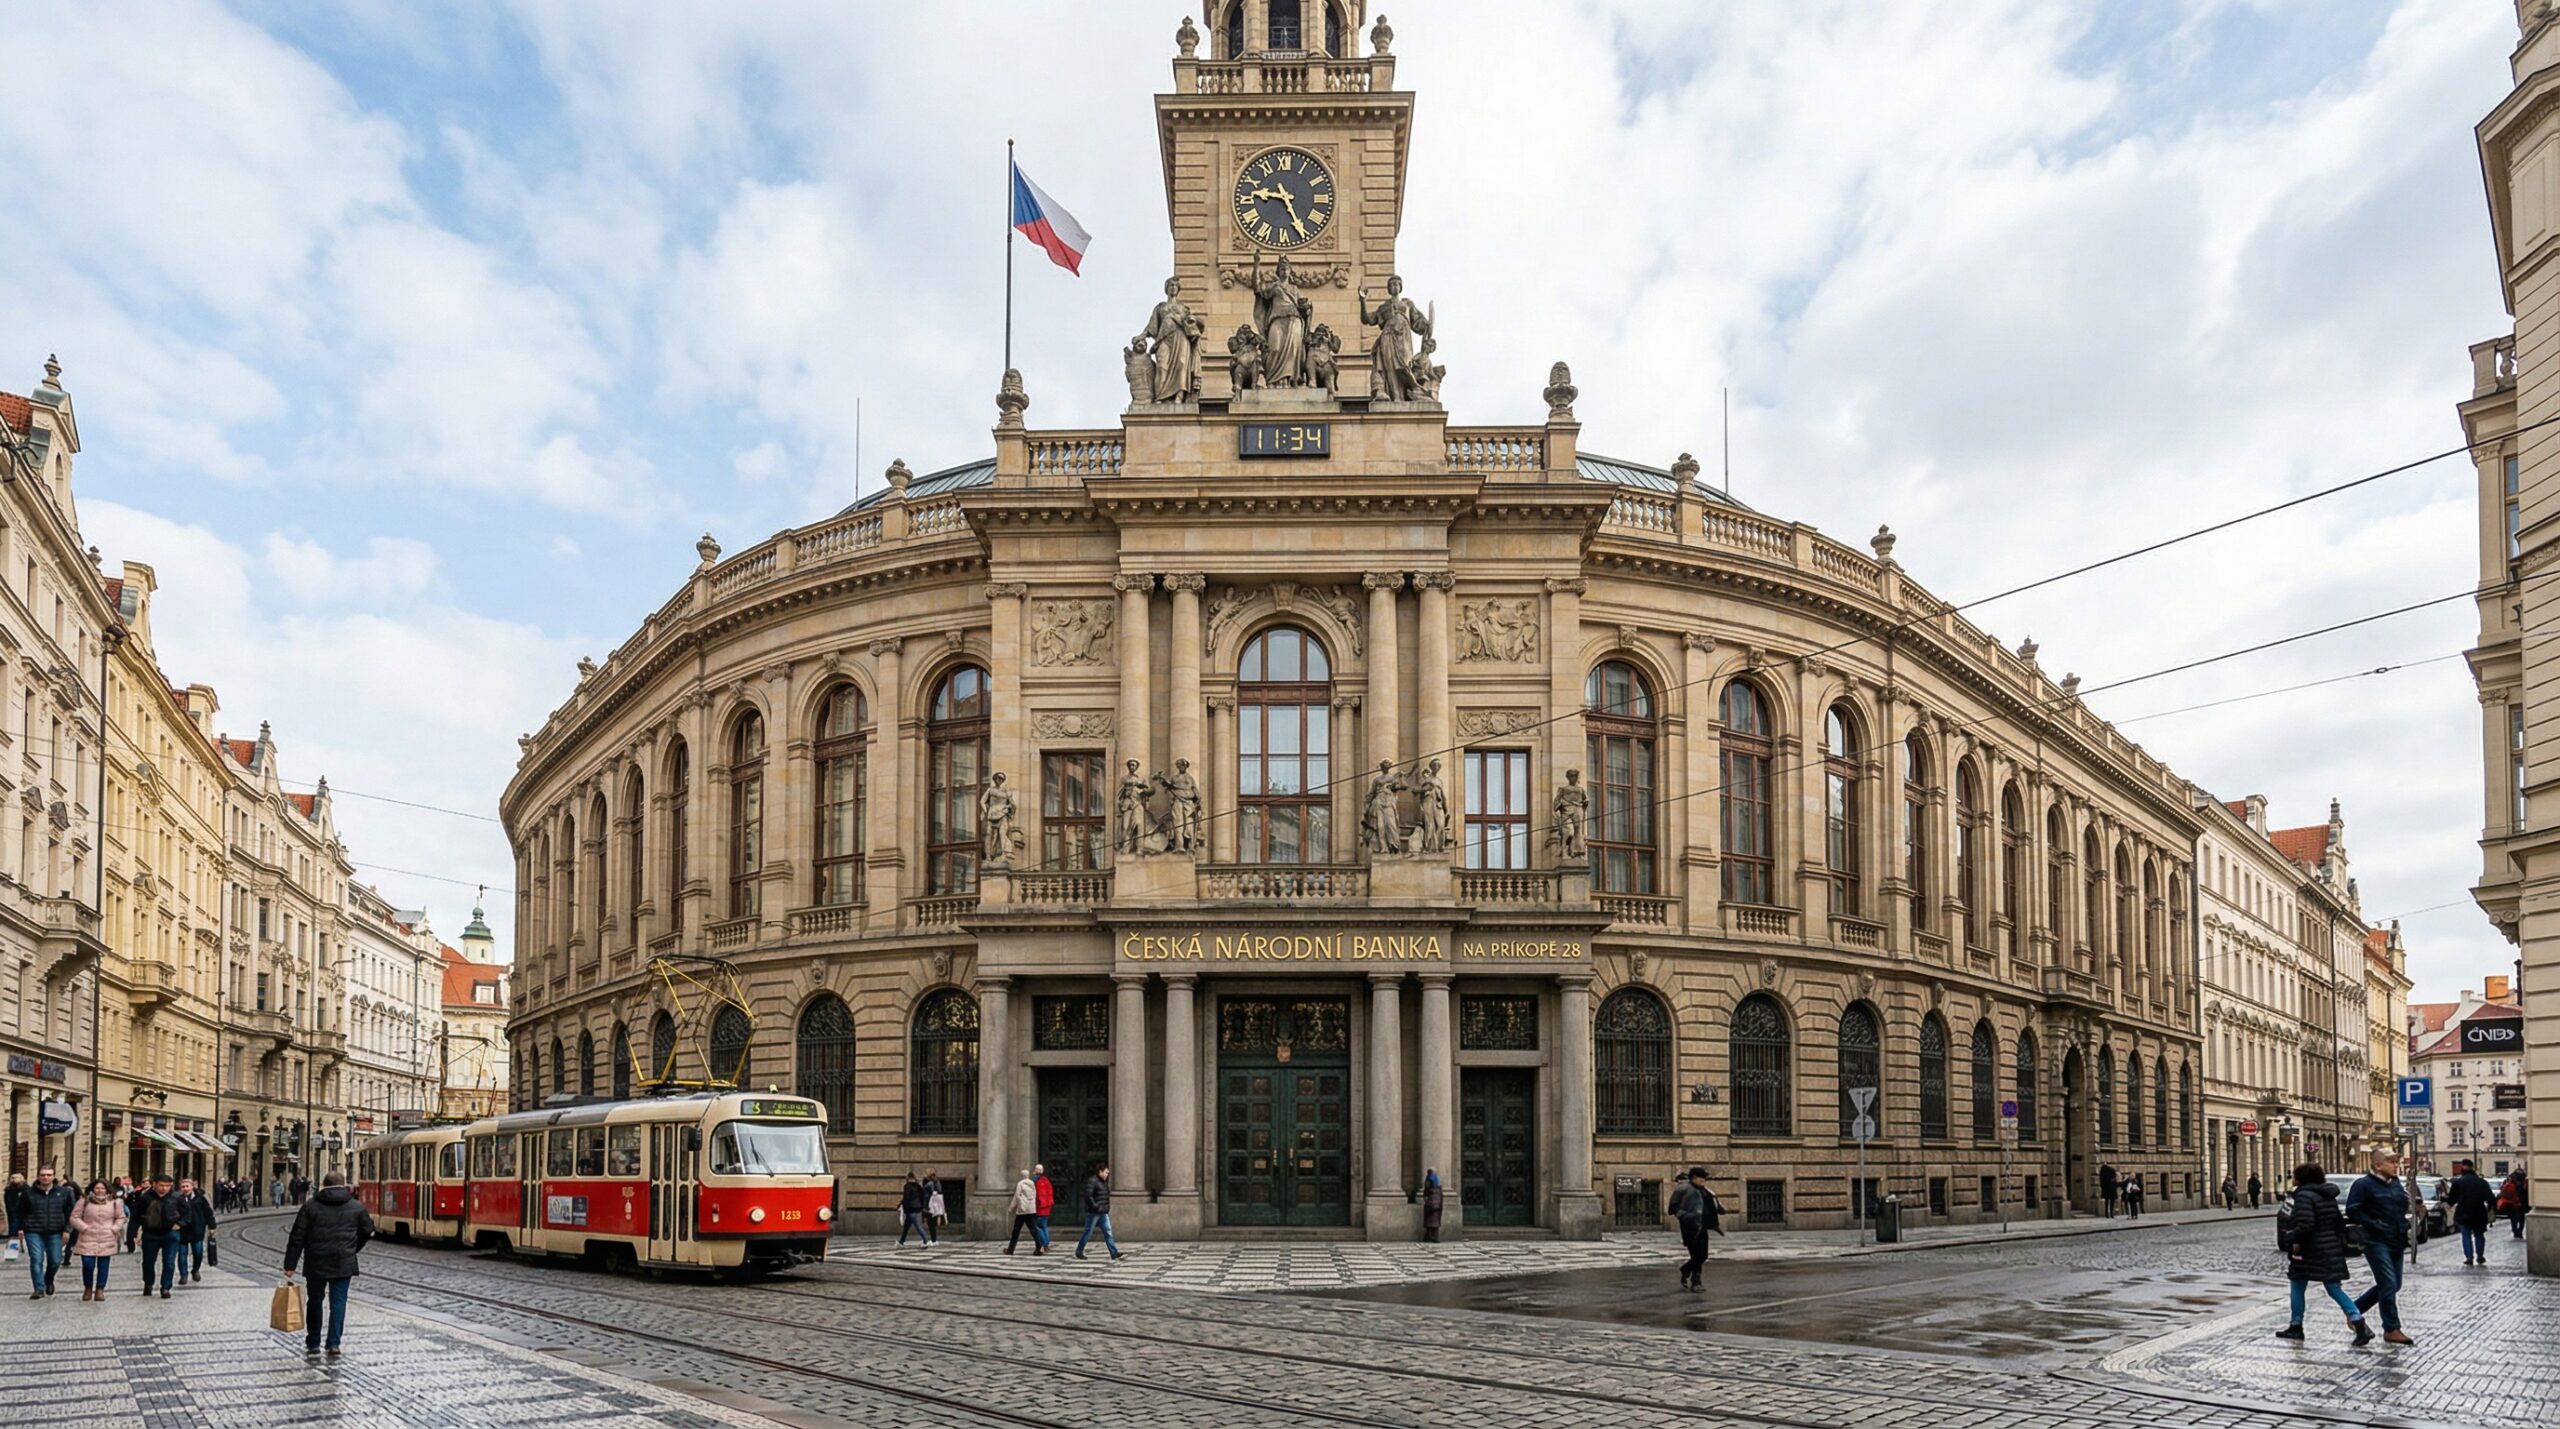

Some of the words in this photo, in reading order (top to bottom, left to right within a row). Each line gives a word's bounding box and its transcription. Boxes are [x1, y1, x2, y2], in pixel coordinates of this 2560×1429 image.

[1297, 160, 1308, 174] I
[1258, 427, 1321, 451] 11:34
[1123, 931, 1204, 959] ČESKÁ
[1215, 931, 1344, 959] NÁRODNÍ
[1352, 936, 1443, 959] BANKA
[1463, 942, 1486, 957] NA
[1561, 943, 1581, 957] 28
[2405, 1081, 2424, 1102] P
